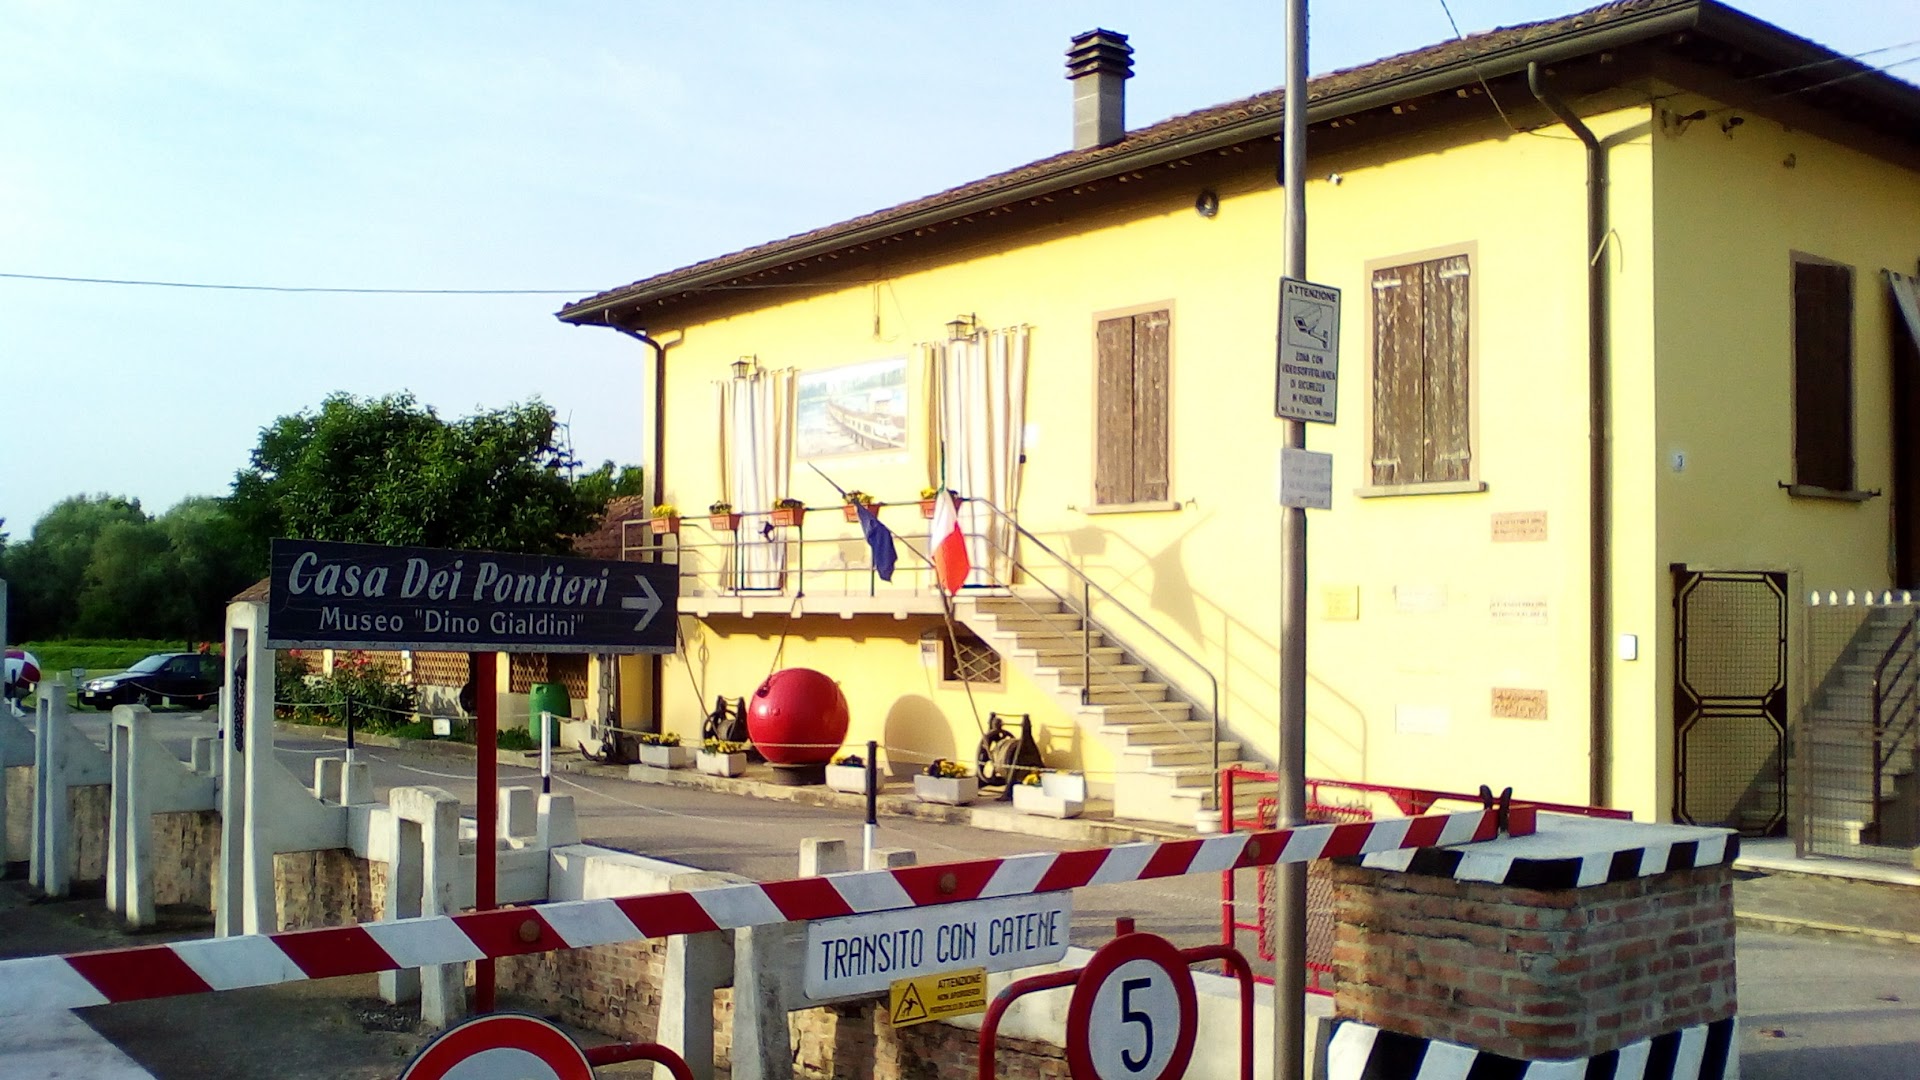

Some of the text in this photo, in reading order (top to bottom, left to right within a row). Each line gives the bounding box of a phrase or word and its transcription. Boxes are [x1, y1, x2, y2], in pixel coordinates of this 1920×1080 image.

[1287, 284, 1337, 303] ATTENZIONE
[1295, 351, 1324, 365] ZONA CON
[288, 551, 609, 606] Casa Dei Pontieri
[318, 606, 585, 636] Museo "Dino Gialdini"
[821, 910, 1062, 981] TRANSITO CON CATENE
[938, 974, 981, 989] ATTENZIONE
[1120, 976, 1154, 1073] 5
